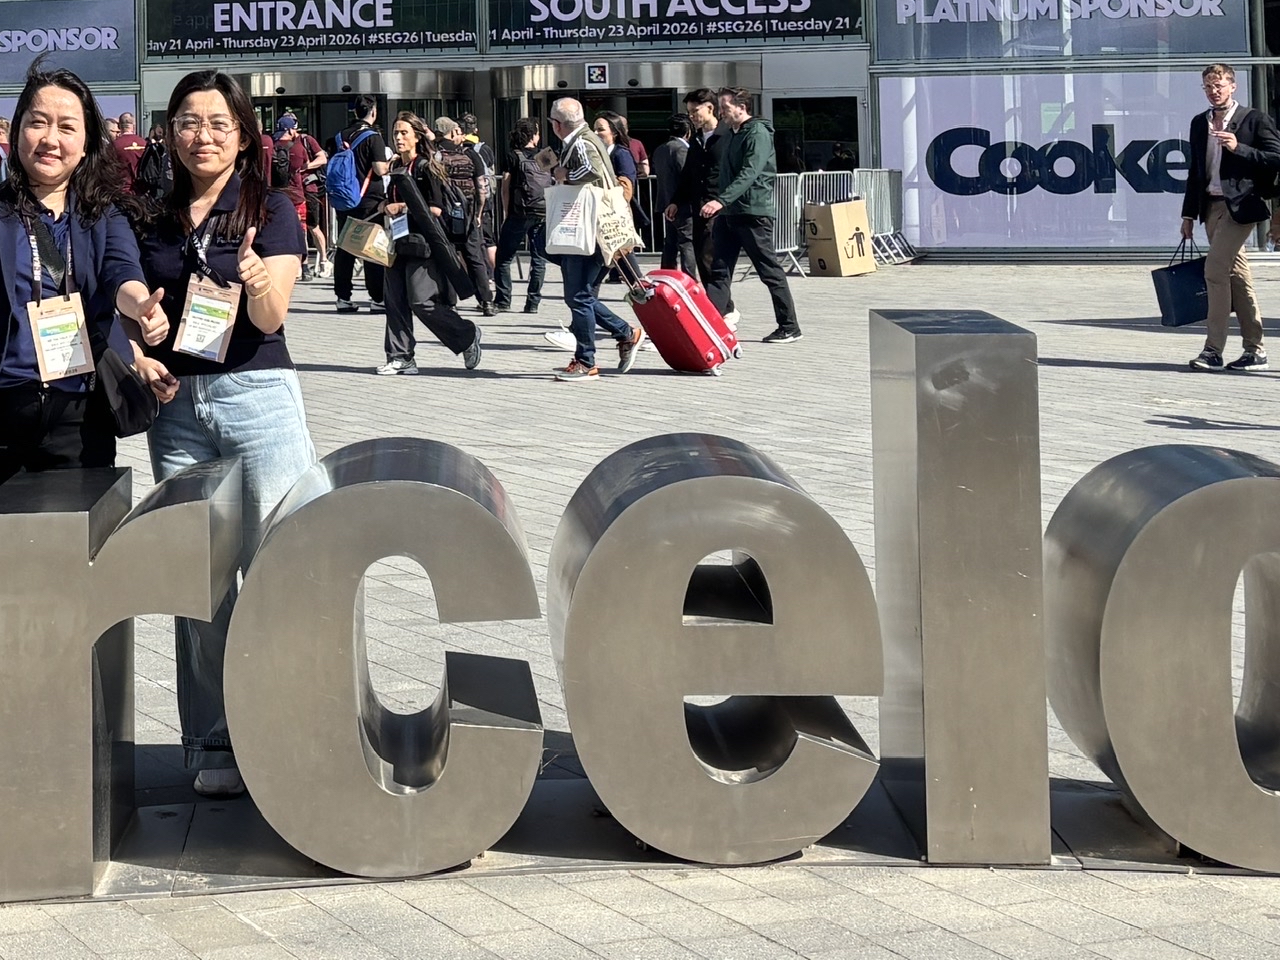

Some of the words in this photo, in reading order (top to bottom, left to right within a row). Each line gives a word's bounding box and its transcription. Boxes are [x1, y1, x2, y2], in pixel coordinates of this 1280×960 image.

[169, 39, 181, 50] 21
[185, 38, 214, 51] April
[222, 37, 278, 50] Thursday
[280, 35, 294, 47] 23
[297, 33, 327, 48] April
[329, 33, 361, 46] 2026
[368, 31, 419, 44] #SEG26
[501, 27, 533, 42] April
[543, 25, 605, 39] Thursday
[608, 25, 624, 37] 23
[626, 23, 659, 38] April
[662, 21, 698, 35] 2026
[706, 19, 763, 33] #SEG26
[770, 17, 832, 33] Tuesday
[835, 16, 849, 29] 21
[925, 124, 1191, 196] Cooke
